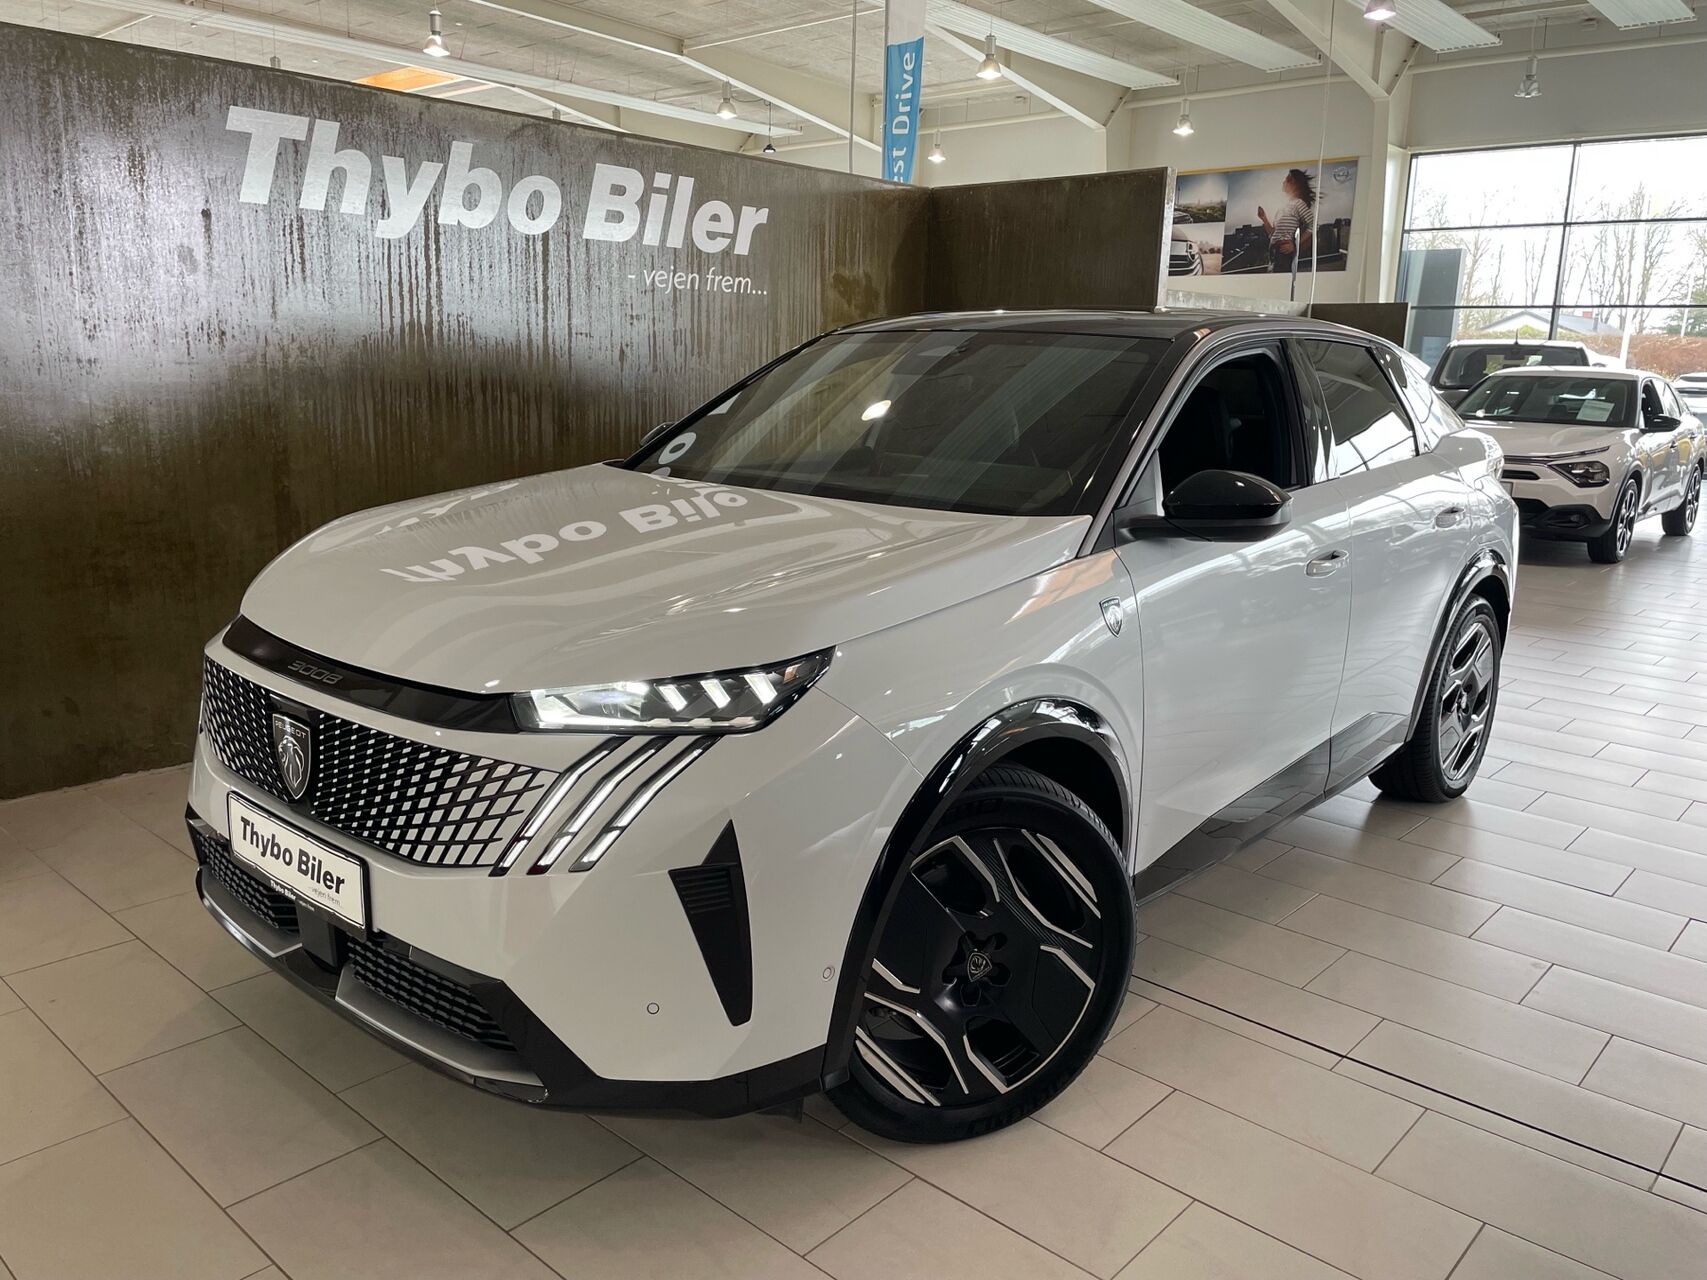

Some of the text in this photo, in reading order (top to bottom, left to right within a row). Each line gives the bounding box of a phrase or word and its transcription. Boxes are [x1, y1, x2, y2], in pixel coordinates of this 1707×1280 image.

[892, 52, 915, 135] Drive
[225, 105, 769, 256] Thybo Biler
[643, 265, 700, 294] vejen
[706, 267, 768, 296] frem...
[287, 660, 344, 685] 3008
[240, 816, 345, 894] Thybo Biler
